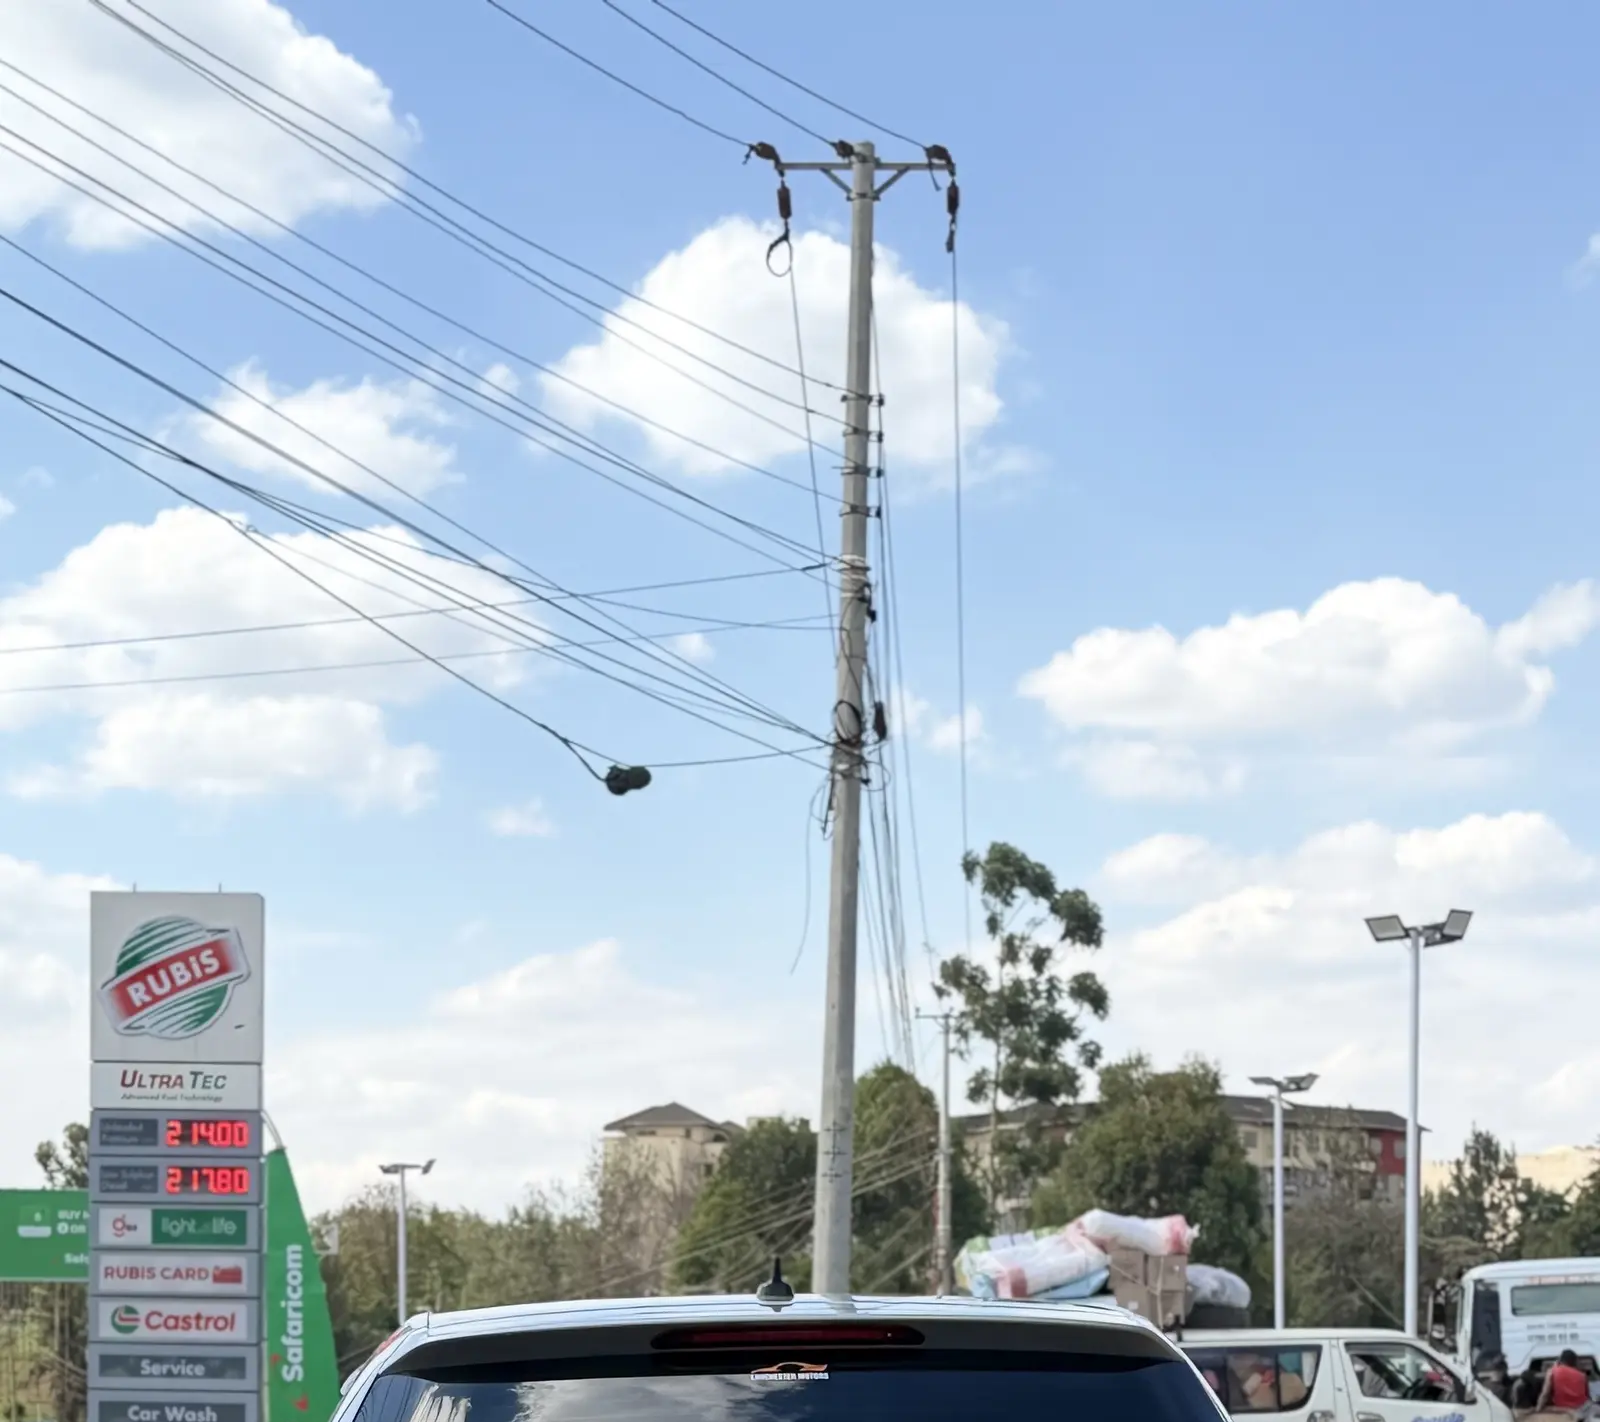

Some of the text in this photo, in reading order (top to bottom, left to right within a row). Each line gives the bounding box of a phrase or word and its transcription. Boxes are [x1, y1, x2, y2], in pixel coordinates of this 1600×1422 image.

[160, 1266, 210, 1281] CARD
[145, 1310, 236, 1333] Castrol
[281, 1244, 304, 1382] Safaricom
[140, 1358, 205, 1377] Service
[127, 1405, 217, 1422] Car Wash
